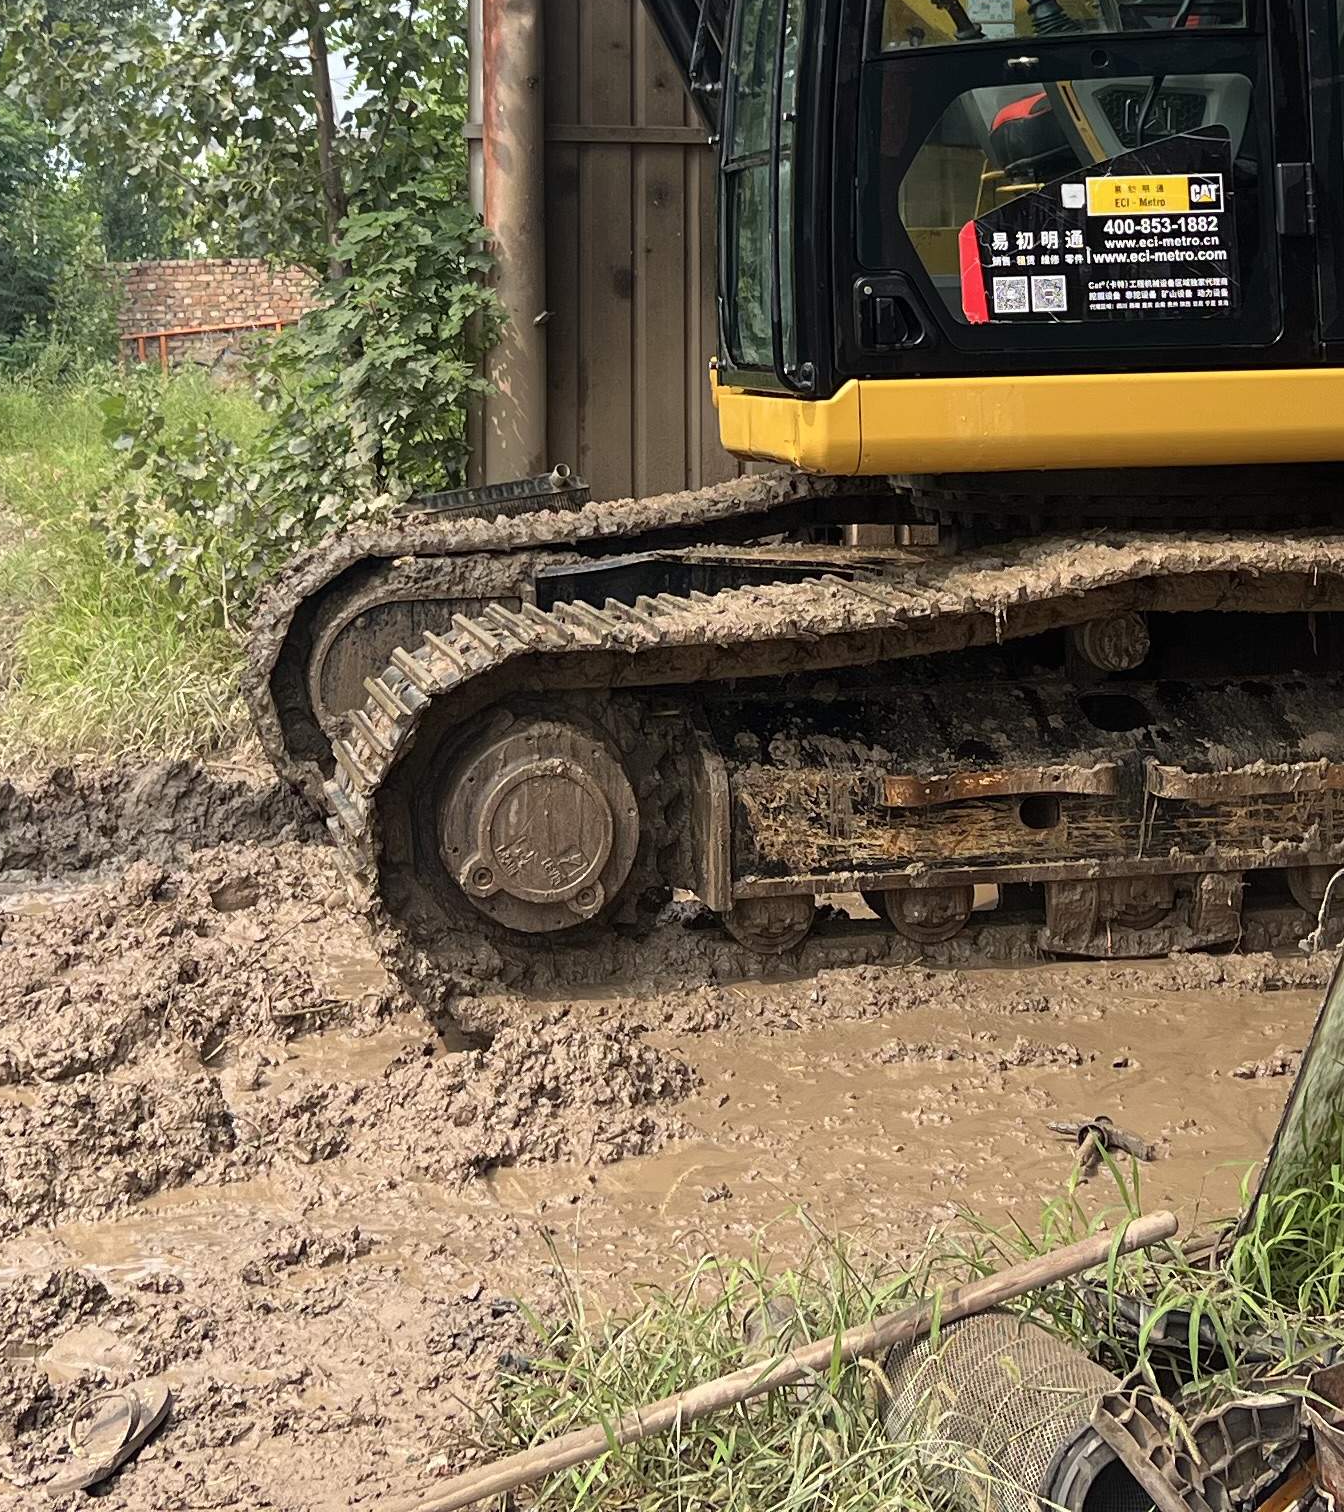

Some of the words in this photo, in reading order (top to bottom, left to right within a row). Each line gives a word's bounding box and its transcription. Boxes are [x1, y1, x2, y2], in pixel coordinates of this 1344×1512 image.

[1190, 184, 1219, 202] CAT
[1115, 198, 1130, 208] ECI
[1139, 198, 1166, 207] Metro
[1103, 216, 1219, 235] 400-853-1882
[992, 230, 1084, 251] 易初明通
[1104, 236, 1220, 249] www.eci-metro.cn
[1093, 249, 1228, 264] www.eci-metro.com
